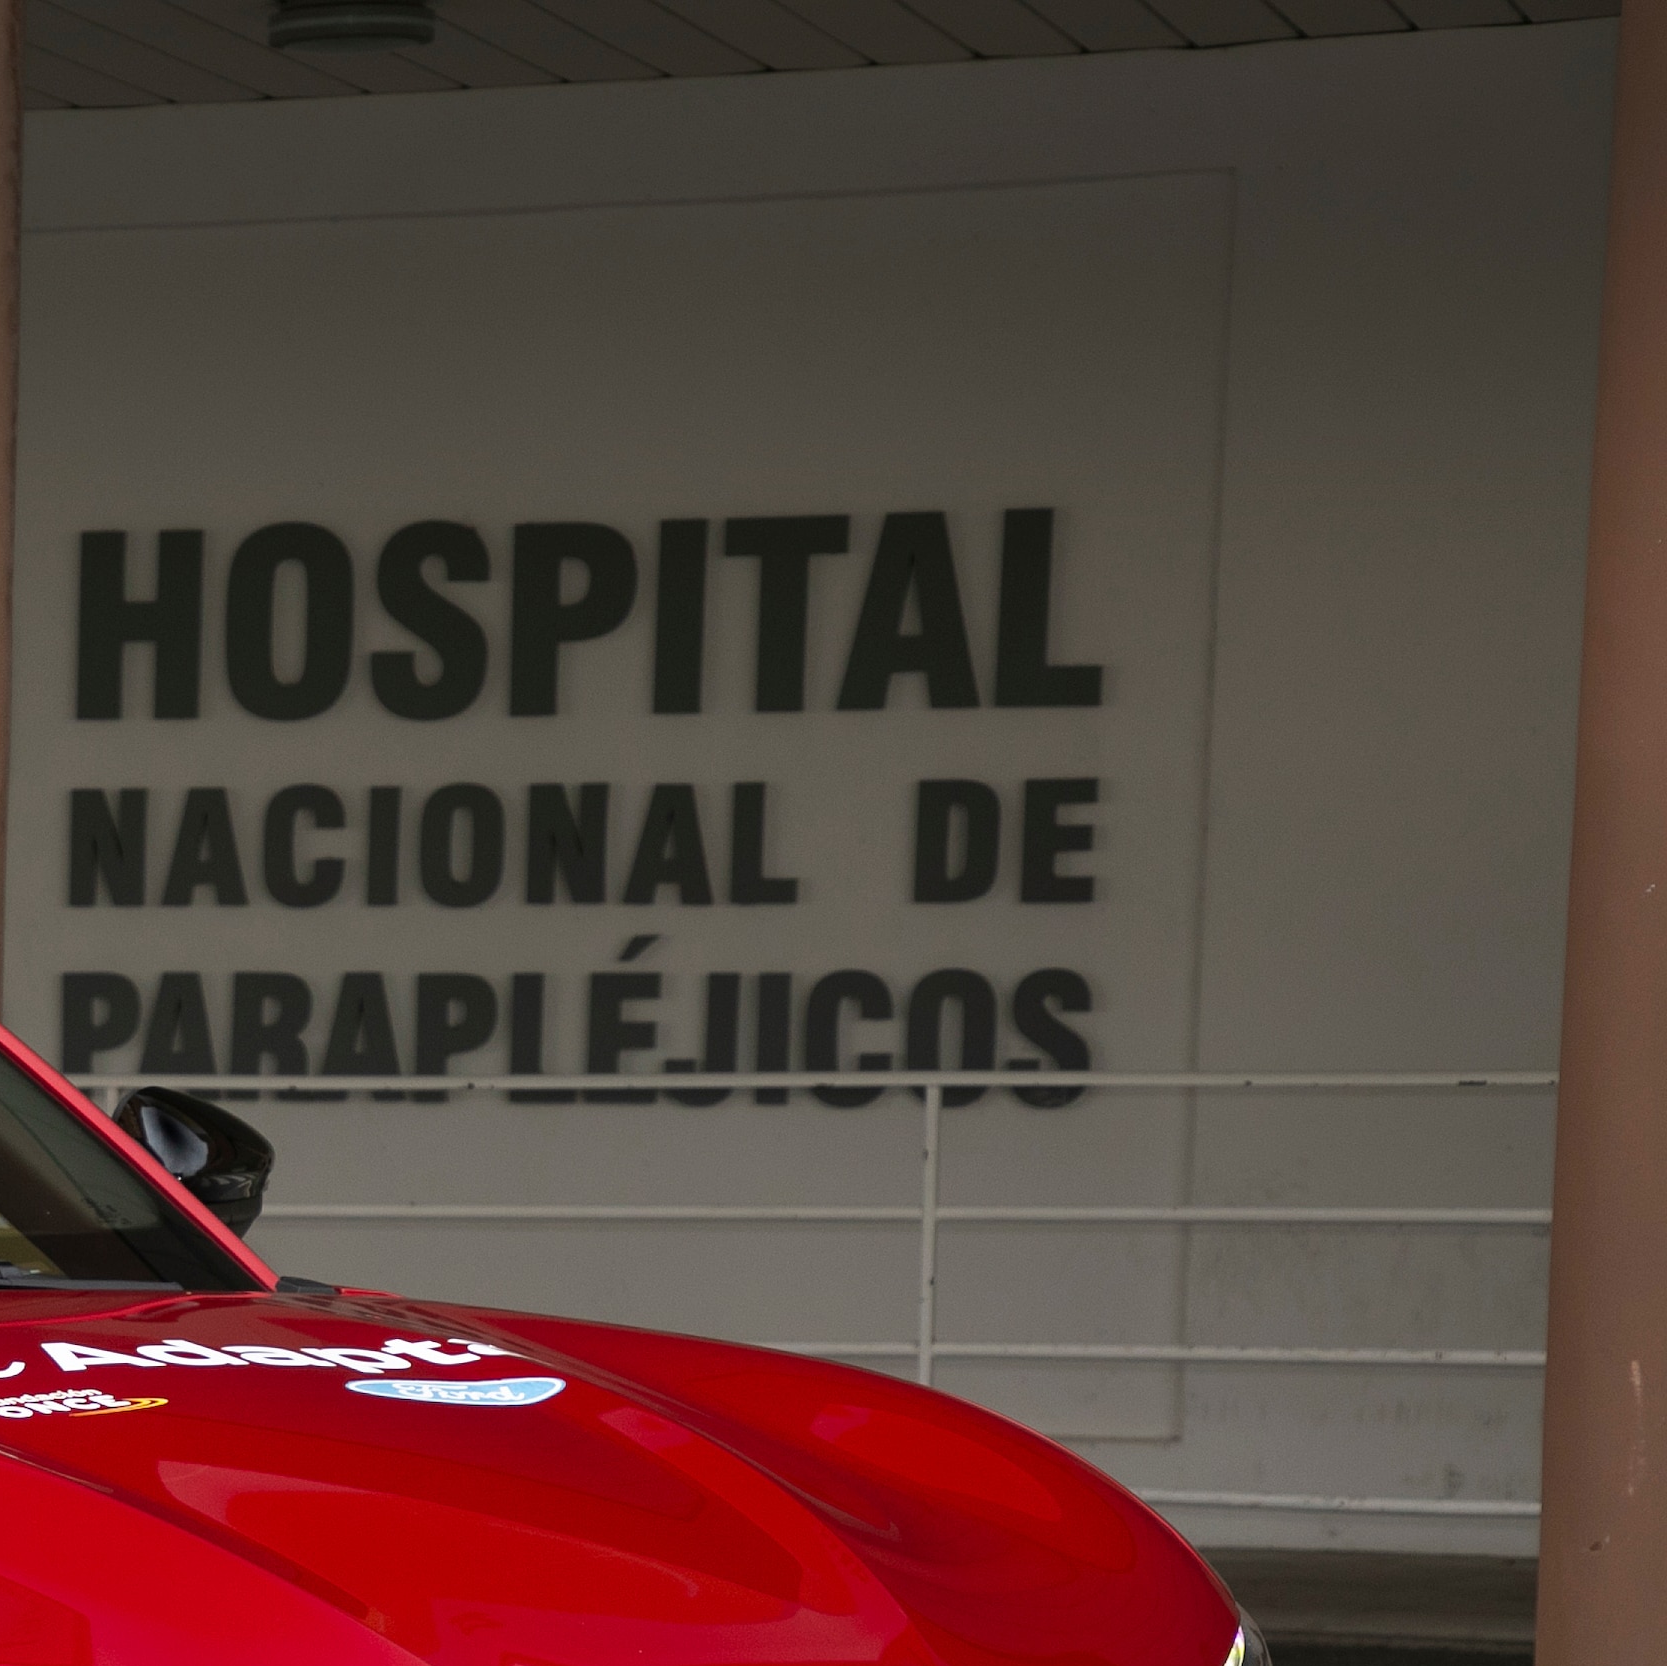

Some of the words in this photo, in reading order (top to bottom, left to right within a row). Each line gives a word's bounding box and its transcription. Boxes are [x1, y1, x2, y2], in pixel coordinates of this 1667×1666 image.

[76, 506, 1104, 722] HOSPITAL
[68, 780, 800, 909] NACIONAL
[911, 777, 1102, 906] DE
[60, 933, 1092, 1109] PARAPLÉJICOS
[40, 1338, 513, 1374] Adapta
[391, 1380, 526, 1402] Ford
